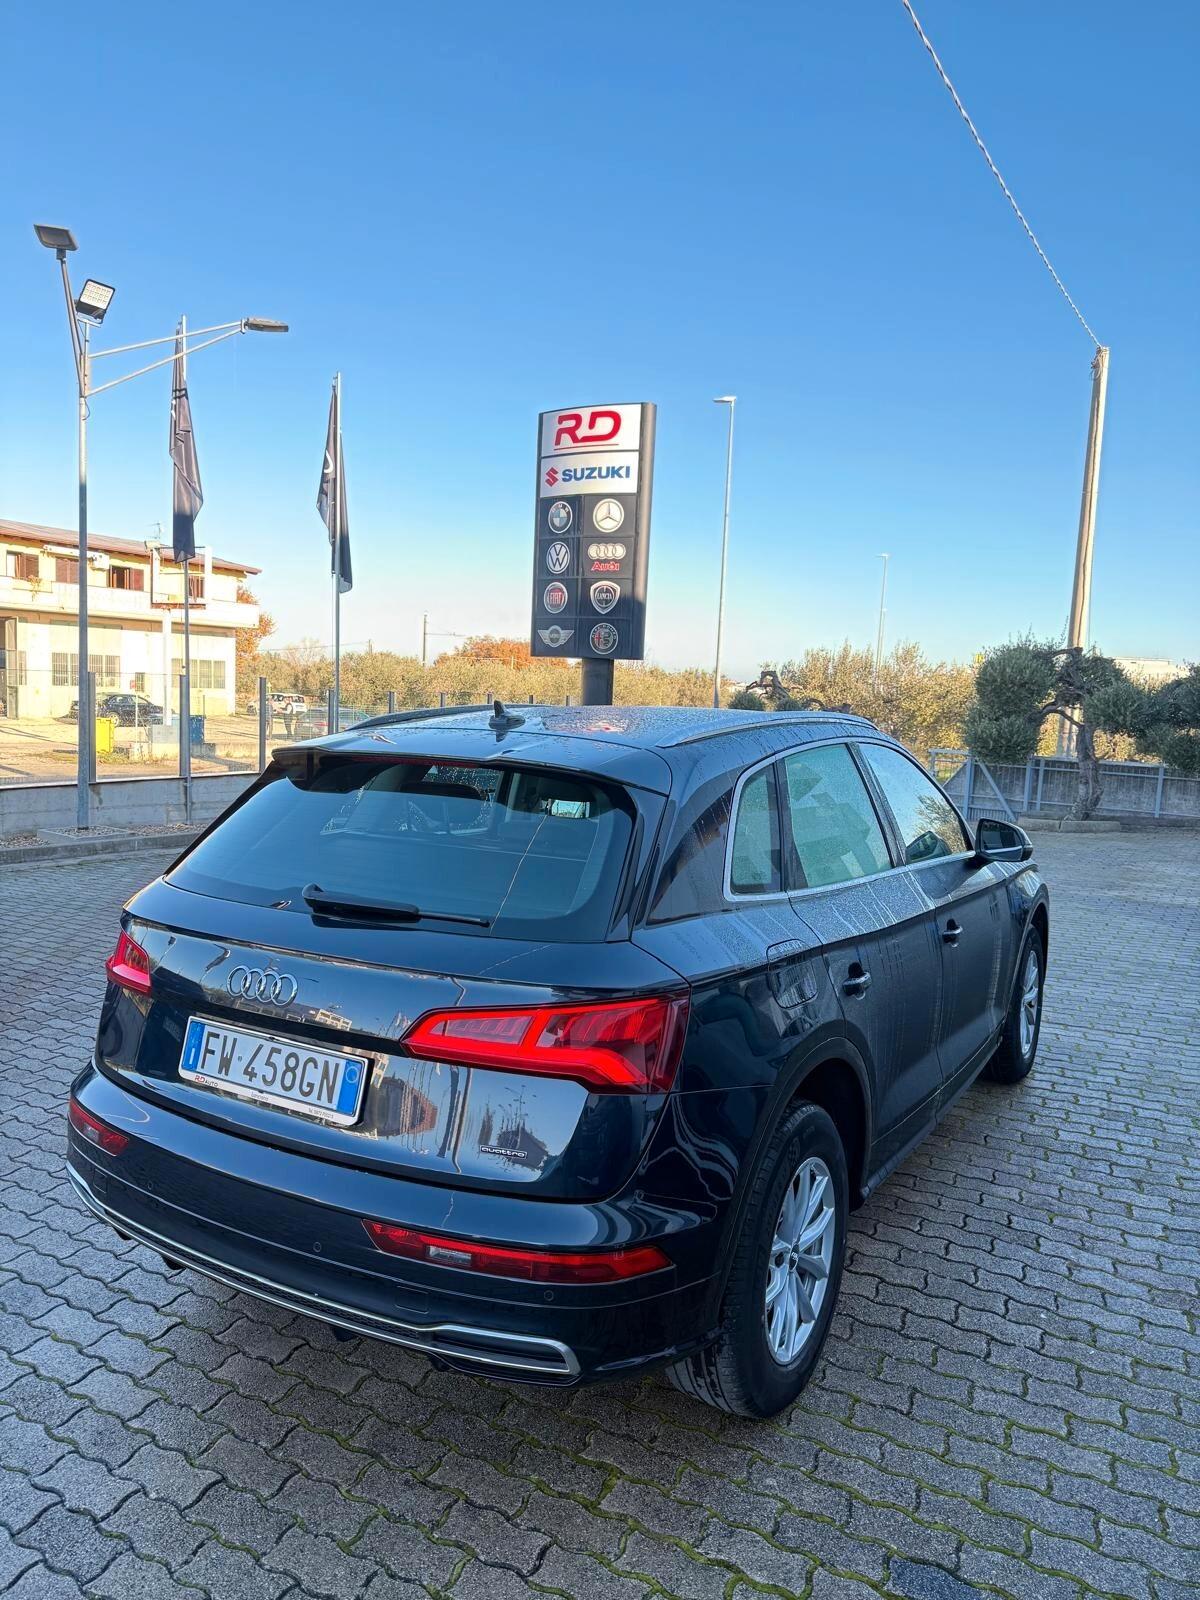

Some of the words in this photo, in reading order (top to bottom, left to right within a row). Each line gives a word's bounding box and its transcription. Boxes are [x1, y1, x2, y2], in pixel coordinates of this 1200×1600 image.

[555, 411, 621, 446] RD
[561, 465, 631, 482] SUZUKI
[591, 561, 620, 571] Audi
[200, 1030, 238, 1077] FW
[243, 1043, 339, 1104] 458GN
[481, 1147, 525, 1158] quattro
